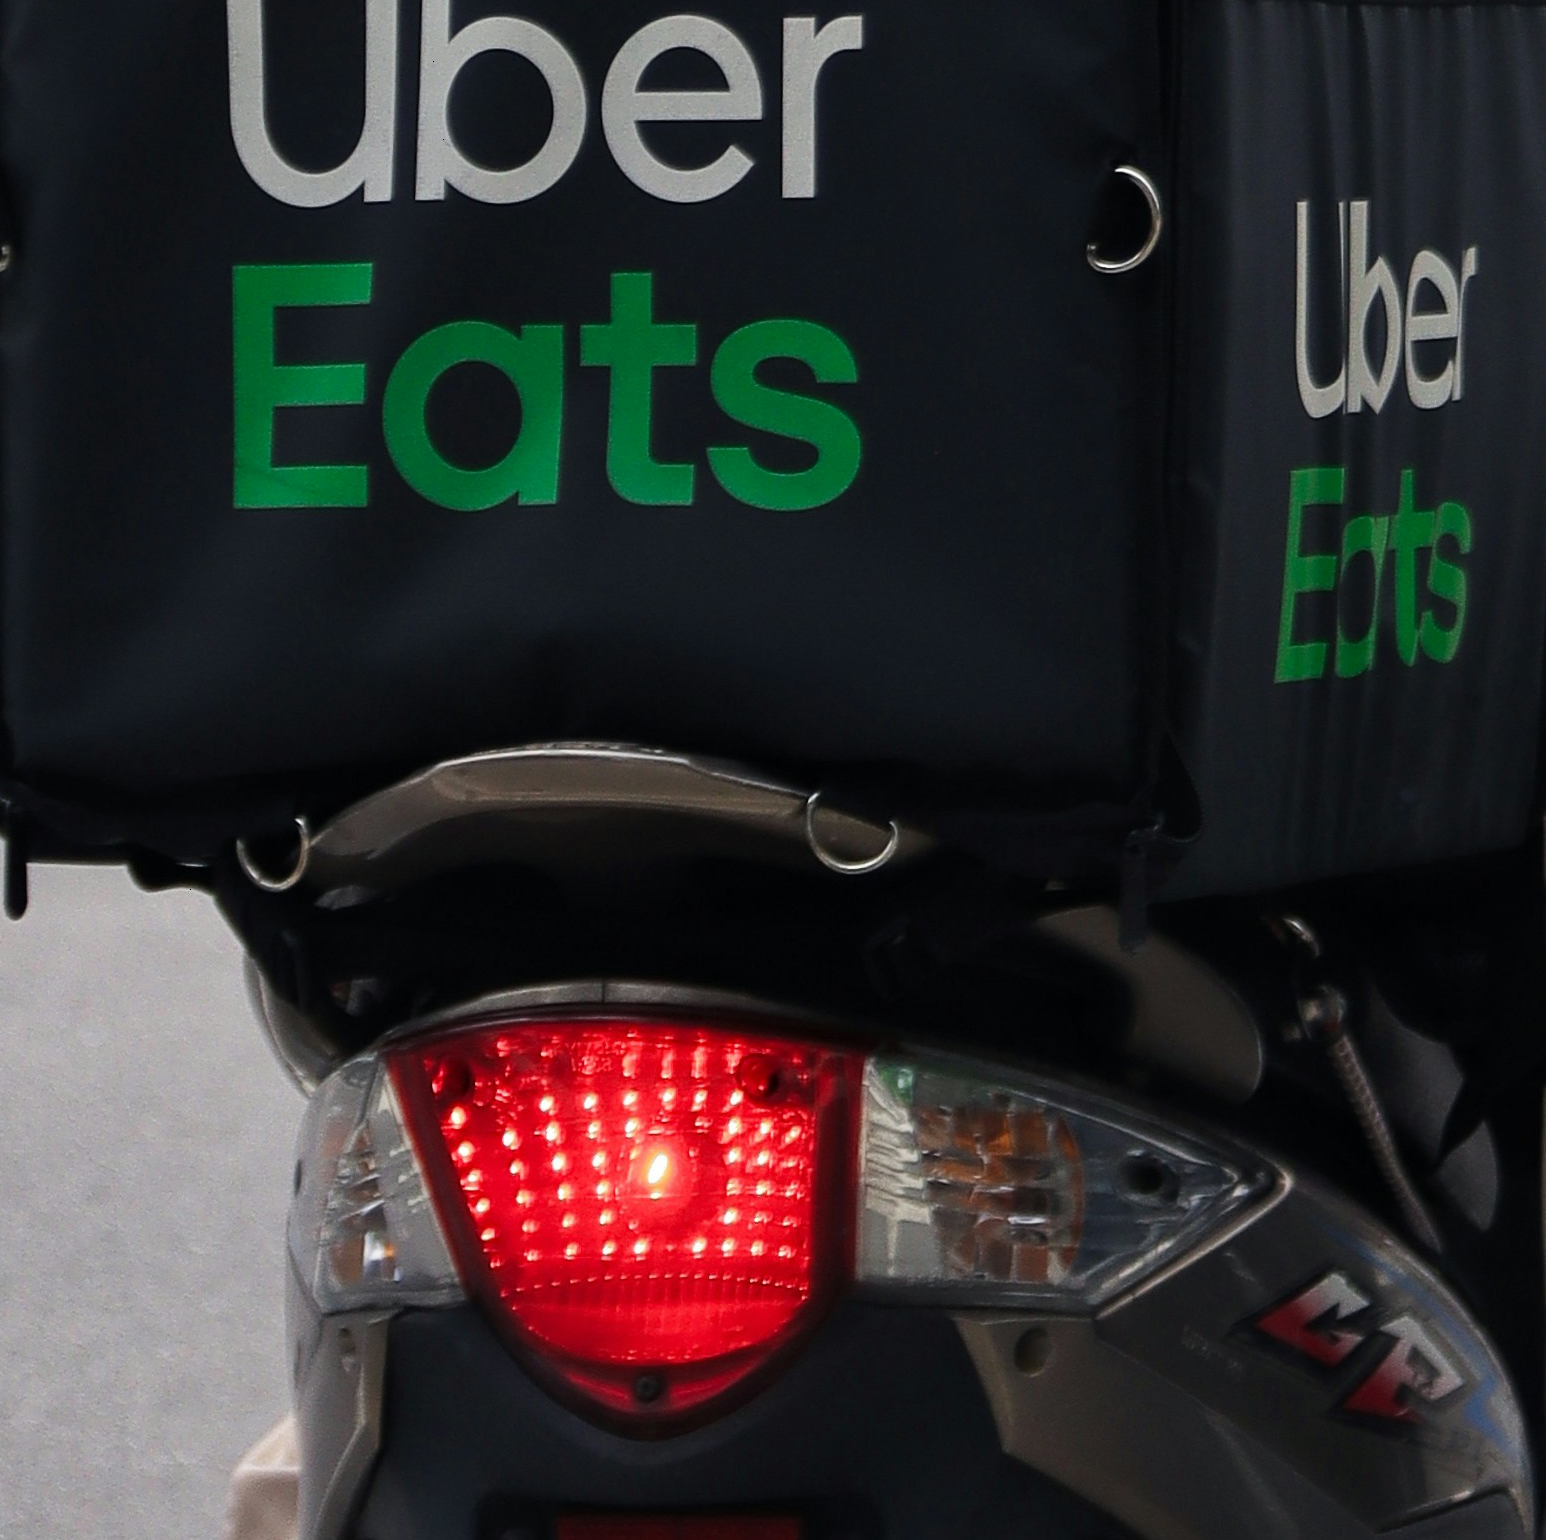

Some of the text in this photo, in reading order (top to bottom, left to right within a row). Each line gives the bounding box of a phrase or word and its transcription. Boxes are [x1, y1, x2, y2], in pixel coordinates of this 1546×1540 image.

[232, 263, 863, 512] Eats
[1296, 199, 1478, 419] Uber
[1274, 467, 1473, 685] Eats
